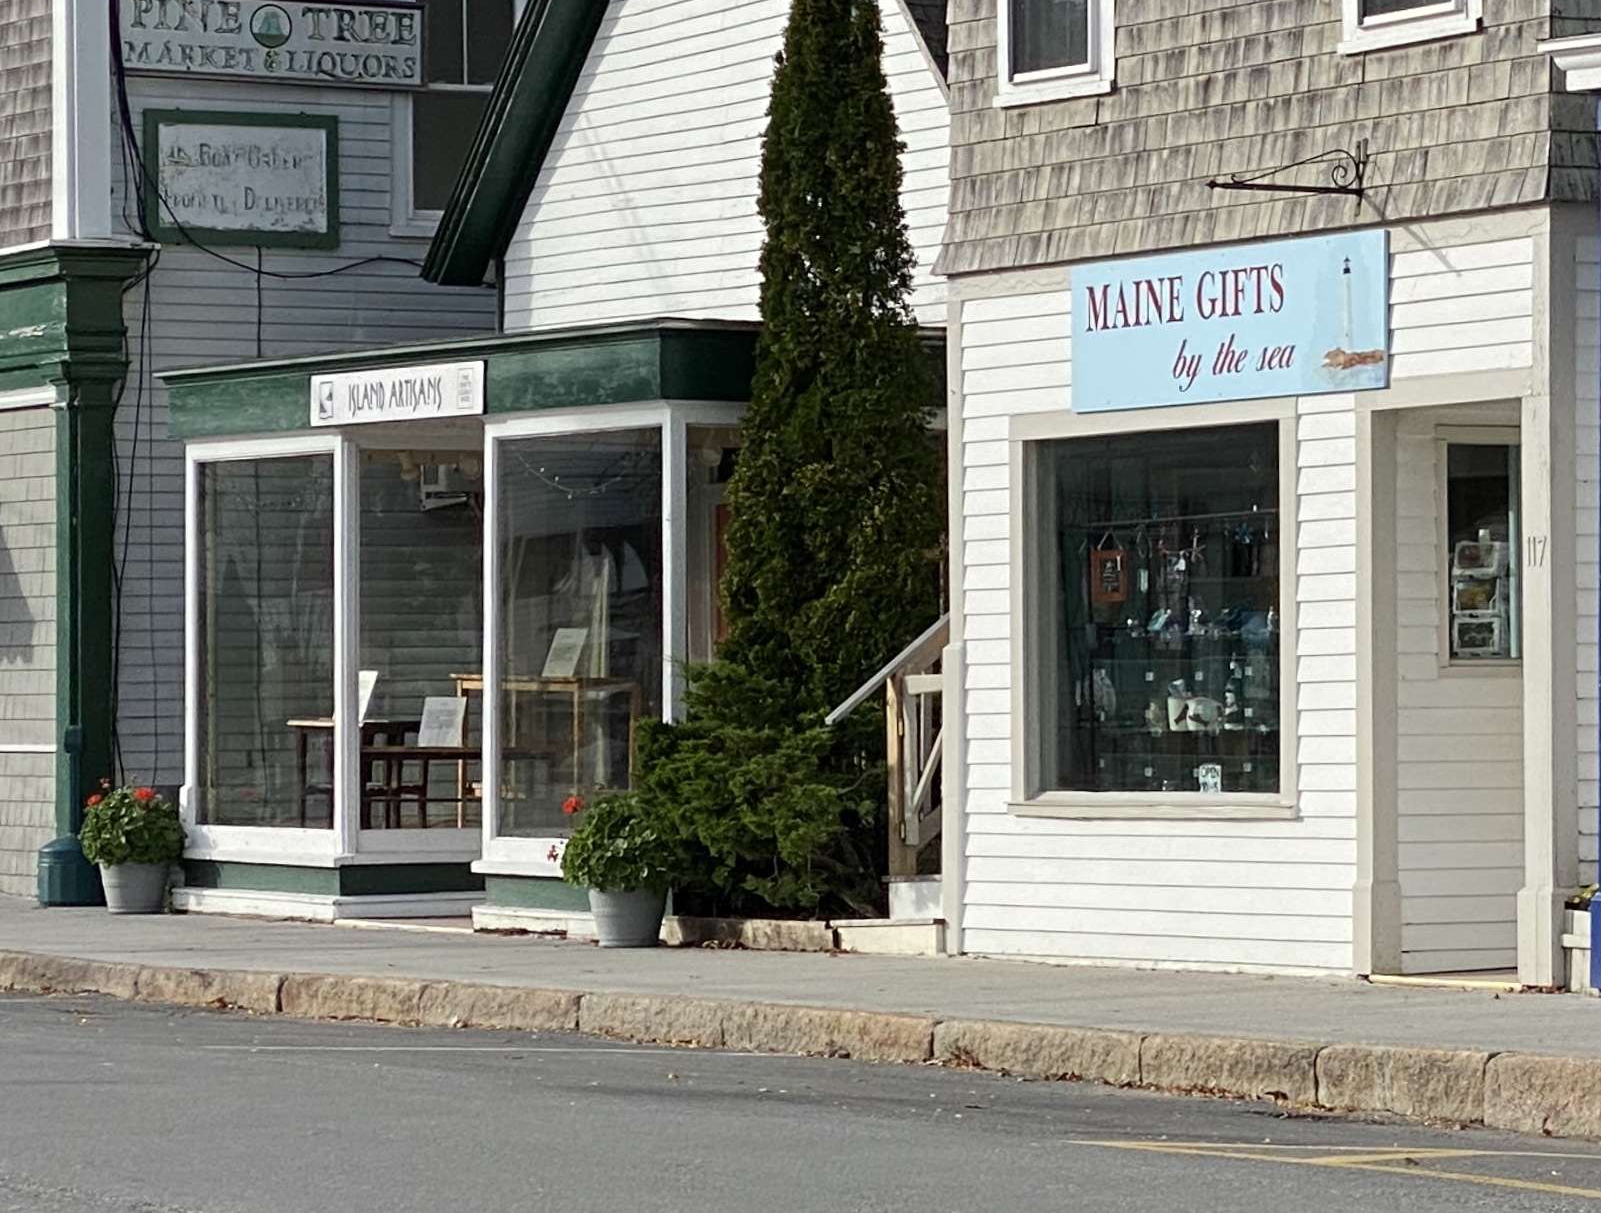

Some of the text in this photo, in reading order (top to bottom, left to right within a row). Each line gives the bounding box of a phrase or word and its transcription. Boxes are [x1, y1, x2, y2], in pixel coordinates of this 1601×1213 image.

[301, 6, 416, 46] TREE
[124, 40, 258, 71] MARKET
[285, 49, 416, 80] LIQUORS
[1086, 263, 1285, 332] MAINE GIFTS
[1173, 333, 1297, 392] by the sea
[348, 381, 385, 418] ISLAND
[389, 375, 442, 414] ARTISANS
[1527, 535, 1548, 567] 117
